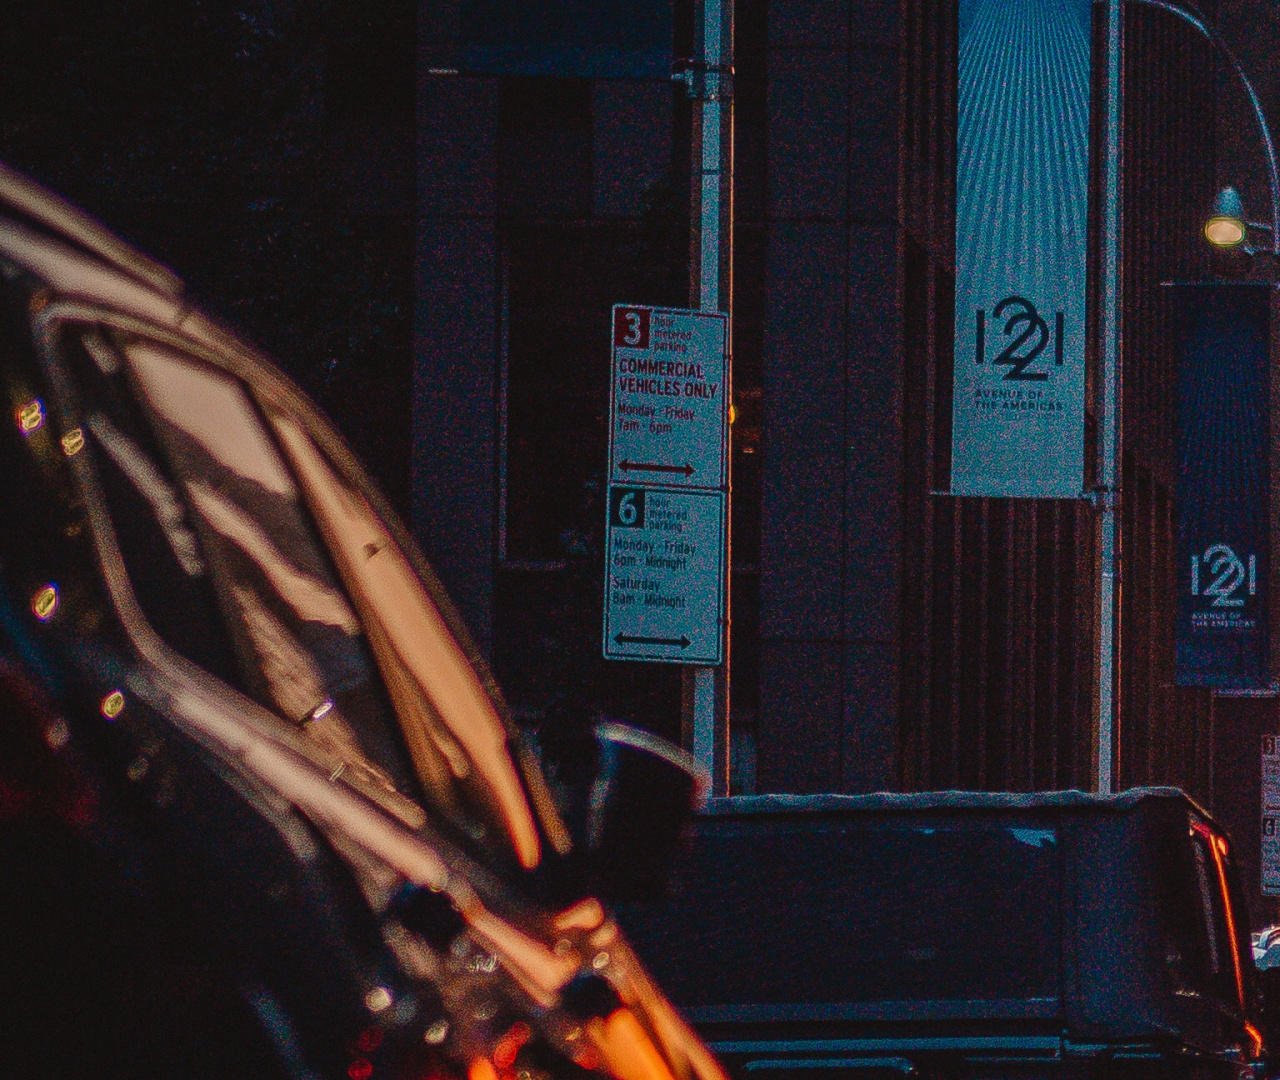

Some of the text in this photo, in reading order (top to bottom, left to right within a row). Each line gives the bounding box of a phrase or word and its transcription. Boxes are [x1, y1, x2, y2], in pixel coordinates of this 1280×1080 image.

[624, 312, 641, 345] 3
[619, 358, 704, 380] COMMERCIAL
[619, 378, 718, 399] VEHICLES ONLY
[975, 389, 1021, 399] AVENUE
[618, 403, 656, 418] Monday
[665, 406, 695, 420] Friday
[1002, 400, 1063, 411] AMERICAS
[619, 492, 637, 525] 6
[613, 538, 654, 553] Monday
[664, 540, 697, 556] Friday
[645, 555, 687, 571] Midnight
[612, 576, 661, 591] Saturday
[644, 592, 686, 609] Midnight
